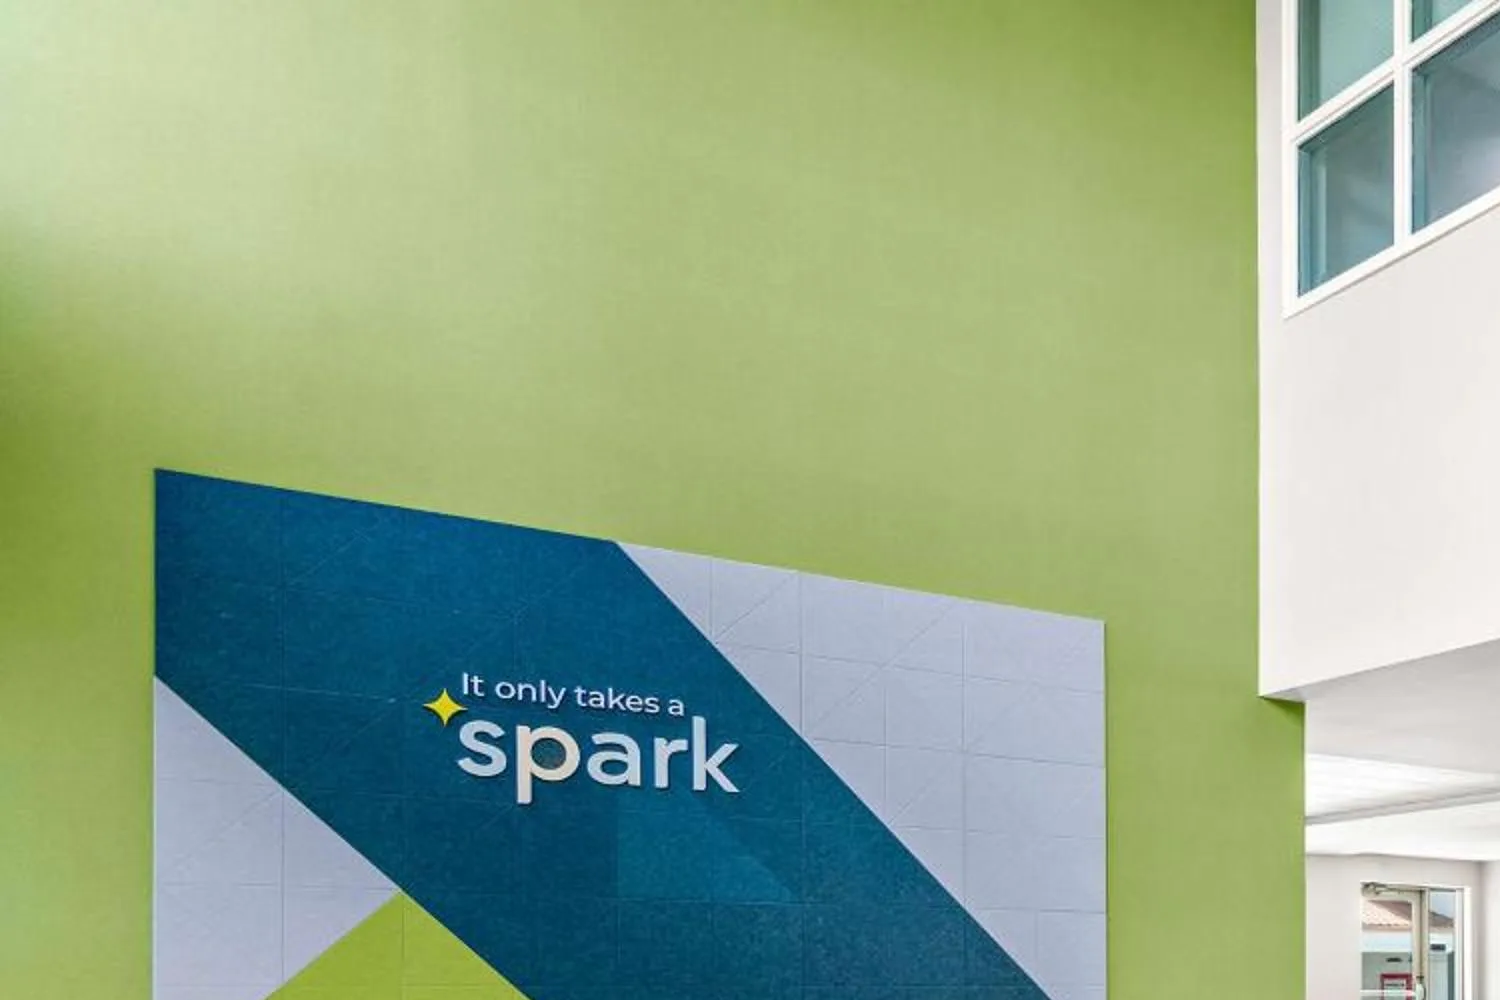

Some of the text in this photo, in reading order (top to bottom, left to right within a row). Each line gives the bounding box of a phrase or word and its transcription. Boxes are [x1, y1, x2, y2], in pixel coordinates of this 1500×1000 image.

[462, 672, 685, 716] It only takes a
[457, 716, 741, 805] spark
